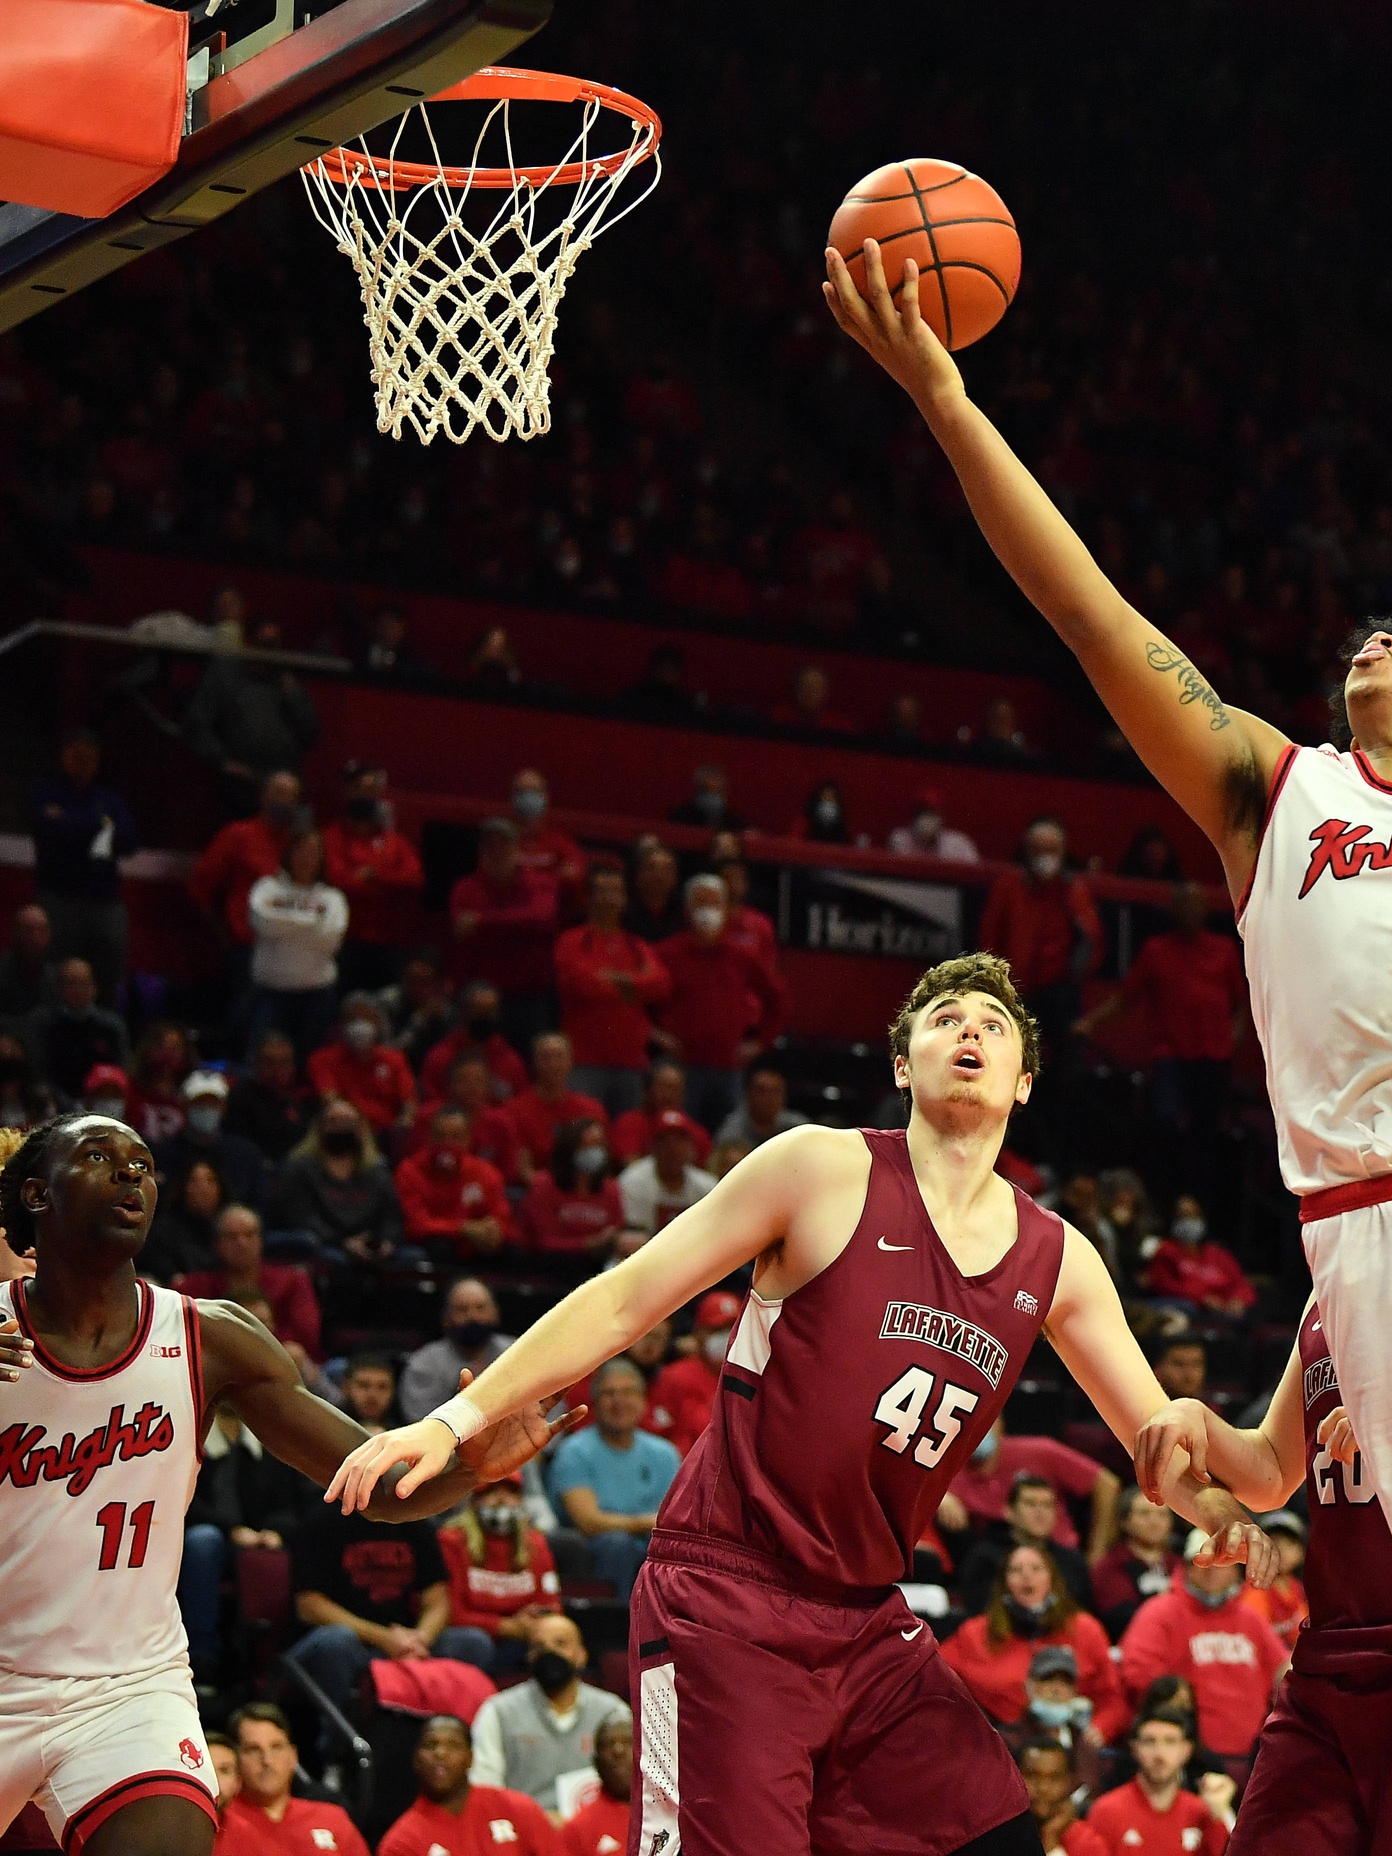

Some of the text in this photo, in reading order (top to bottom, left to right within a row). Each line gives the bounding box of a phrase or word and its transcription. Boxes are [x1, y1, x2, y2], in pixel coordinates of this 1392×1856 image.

[882, 1303, 1007, 1387] LAFAYETTE
[0, 1401, 174, 1497] Knights
[871, 1363, 981, 1471] 45
[96, 1501, 155, 1571] 11
